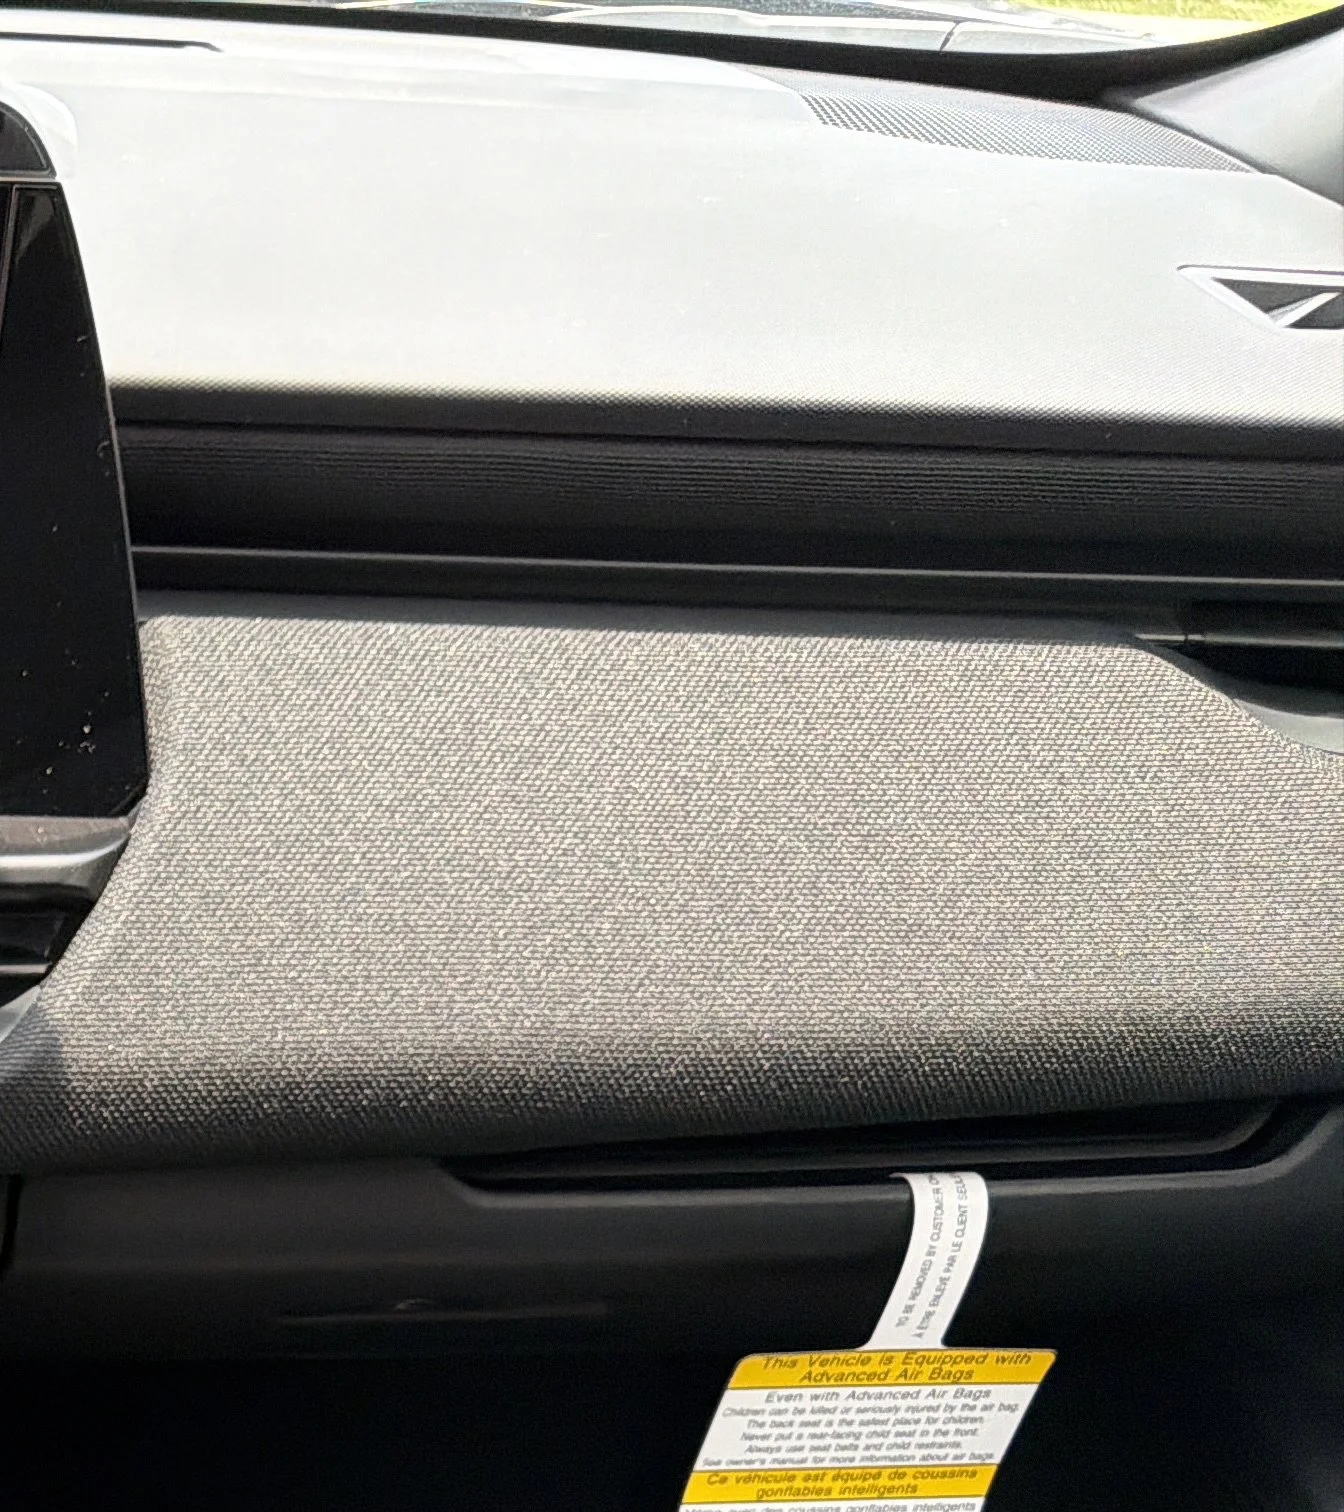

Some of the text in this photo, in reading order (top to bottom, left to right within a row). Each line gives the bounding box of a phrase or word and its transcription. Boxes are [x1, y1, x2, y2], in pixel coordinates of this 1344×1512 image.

[763, 1351, 1032, 1370] This Vehicle is Equipped with
[800, 1367, 975, 1383] Advanced Air Bags
[764, 1387, 992, 1403] Even with Advanced Air Bags
[801, 1470, 826, 1483] est
[887, 1468, 908, 1480] de
[911, 1468, 979, 1481] coussins
[755, 1482, 919, 1500] gonflables intelligents
